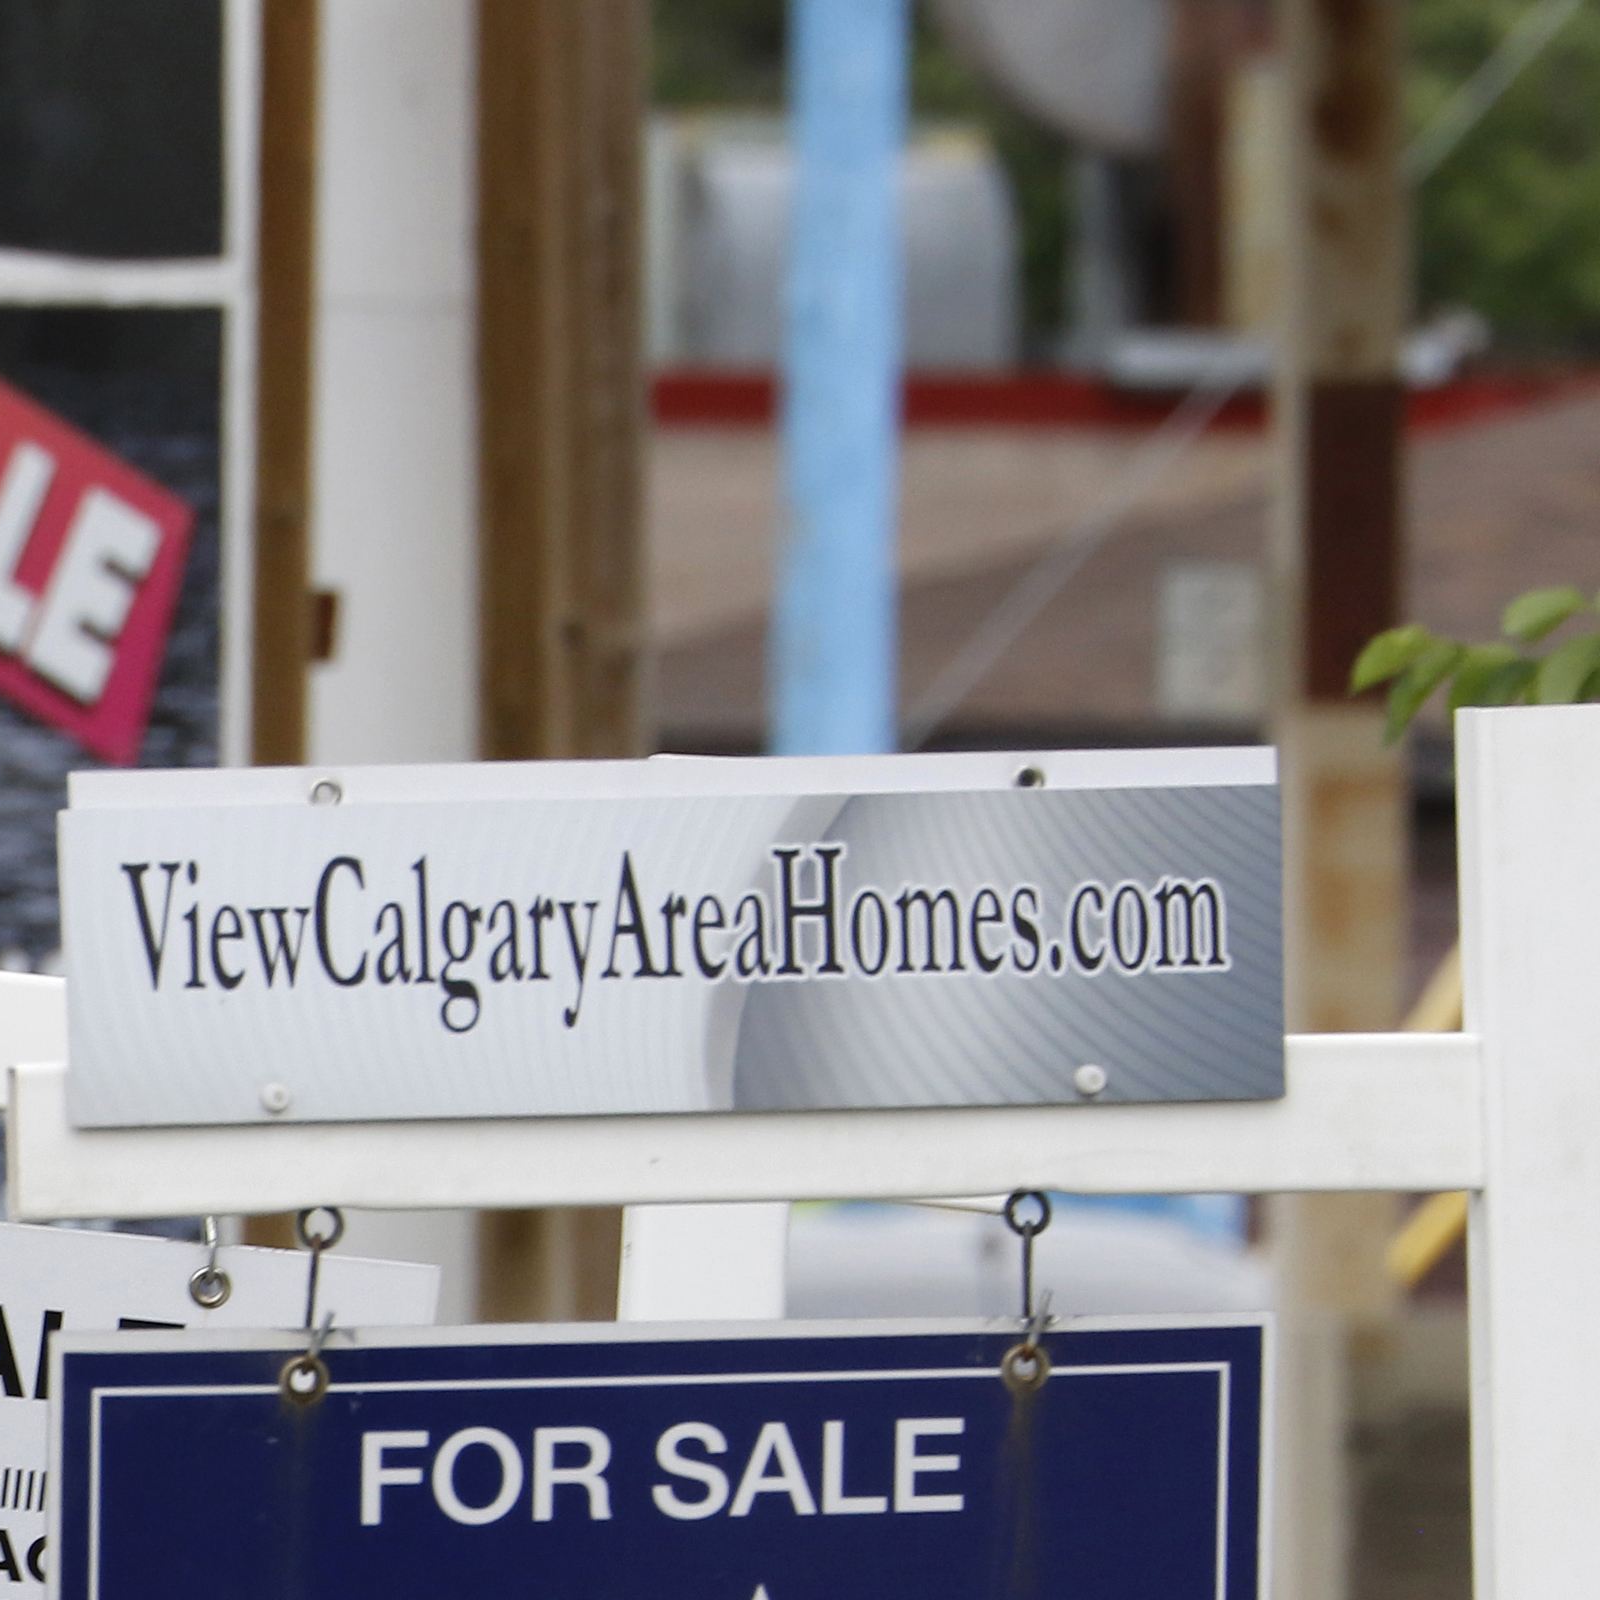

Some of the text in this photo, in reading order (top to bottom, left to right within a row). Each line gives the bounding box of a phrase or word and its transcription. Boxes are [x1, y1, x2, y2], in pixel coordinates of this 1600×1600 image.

[121, 846, 1229, 1033] ViewCalgaryAreaHomes.com
[361, 1417, 965, 1526] FOR SALE
